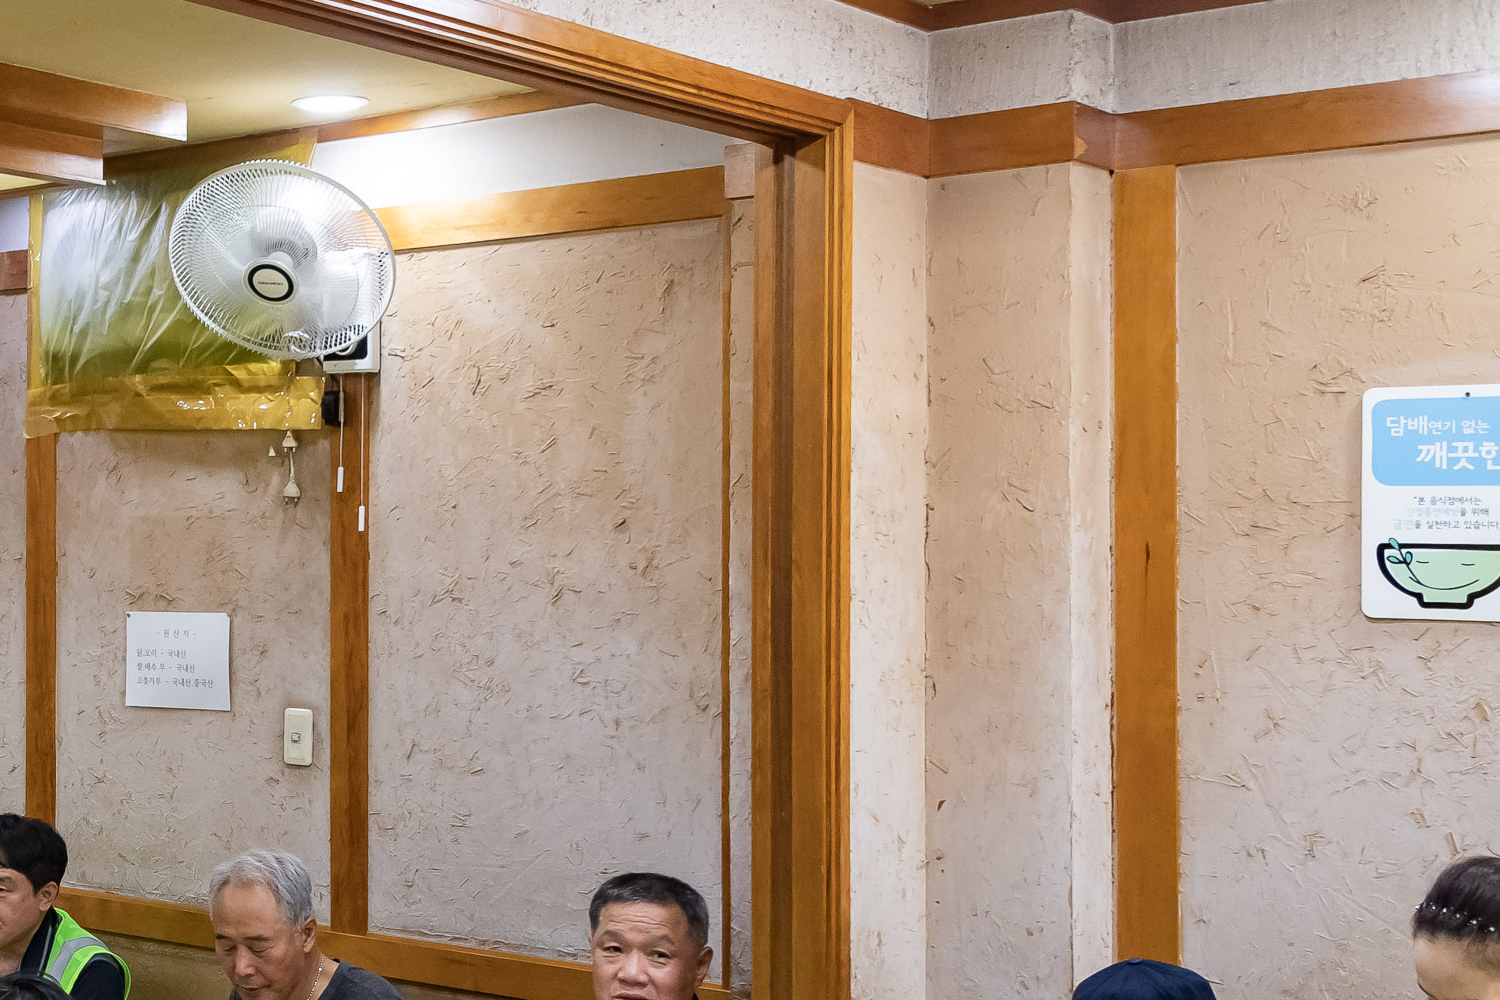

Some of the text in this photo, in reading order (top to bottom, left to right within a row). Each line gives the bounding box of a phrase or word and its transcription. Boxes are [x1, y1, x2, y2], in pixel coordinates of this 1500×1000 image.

[1461, 420, 1491, 435] 없는
[1429, 496, 1482, 506] 음식점에서는
[1471, 507, 1489, 516] 위해
[1426, 520, 1460, 529] 실천하고
[168, 649, 187, 659] 국내산
[176, 664, 195, 673] 국내산
